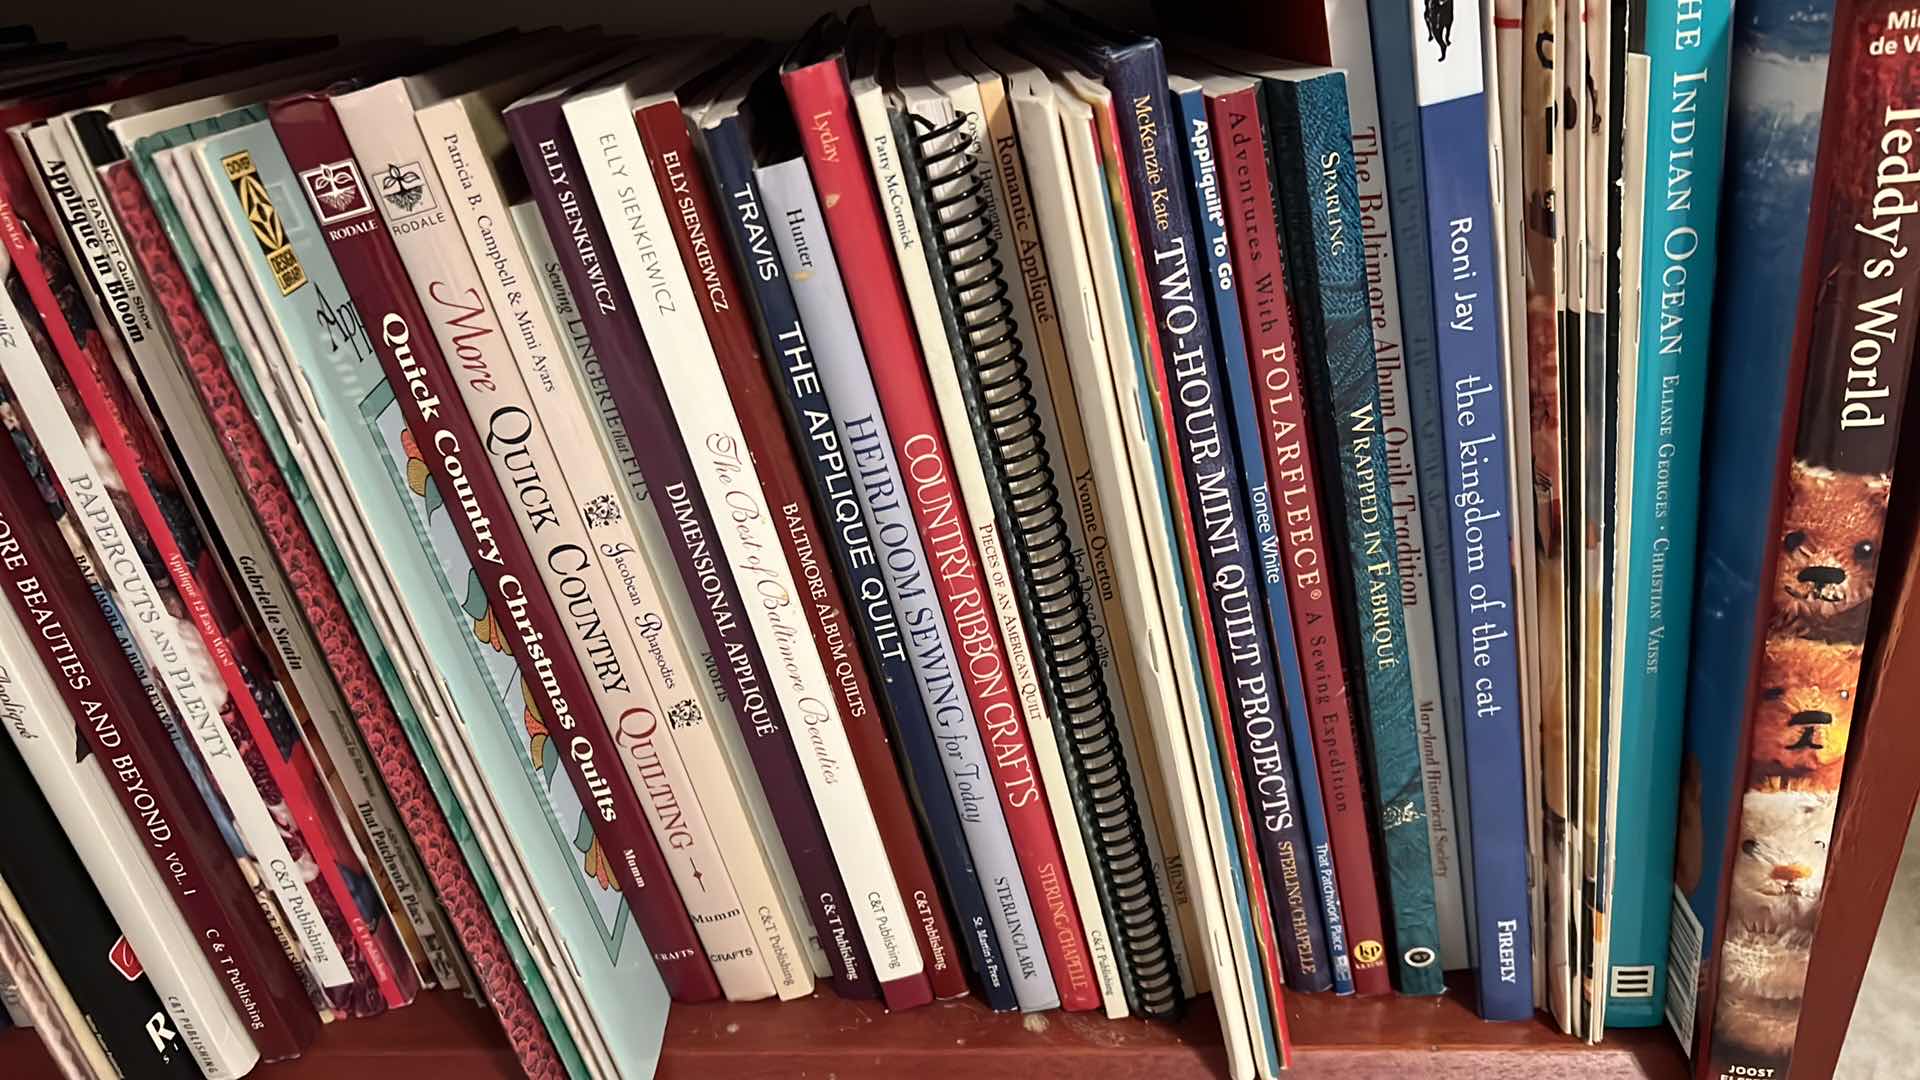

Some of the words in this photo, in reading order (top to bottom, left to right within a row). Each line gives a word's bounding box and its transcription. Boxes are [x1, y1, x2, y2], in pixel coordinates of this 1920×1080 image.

[1869, 36, 1898, 55] de
[813, 111, 839, 162] Lyday
[1134, 96, 1162, 184] McKenzie
[1151, 188, 1169, 230] Kate
[1350, 126, 1378, 184] The
[1667, 71, 1706, 210] INDIAN
[392, 212, 446, 236] RODALE
[540, 140, 569, 184] ELLY
[559, 192, 615, 313] SIENKIEWICZ
[600, 134, 627, 176] ELLY
[618, 187, 675, 314] SIENKIEWICZ
[875, 136, 889, 169] Patty
[885, 174, 913, 249] McCormick
[1229, 113, 1260, 260] Adventures
[1321, 152, 1349, 255] SPARLING
[87, 199, 120, 254] BASKET
[117, 261, 139, 291] Quilt
[133, 296, 151, 329] Show
[329, 220, 378, 240] RODALE
[444, 134, 472, 189] Patricia
[468, 194, 481, 210] B.
[478, 216, 515, 286] Campbell
[508, 292, 521, 305] &
[515, 311, 540, 349] Mimi
[532, 356, 554, 392] Ayars
[663, 151, 689, 192] ELLY
[679, 198, 728, 312] SIENKIEWICZ
[735, 184, 778, 280] TRAVIS
[787, 210, 812, 266] Hunter
[997, 135, 1036, 230] Romantic
[1020, 238, 1056, 322] Appliqué
[1213, 232, 1227, 257] To
[1357, 194, 1387, 330] Baltimore
[1451, 218, 1476, 280] Roni
[94, 254, 112, 275] in
[107, 280, 144, 342] Bloom
[1218, 263, 1232, 289] Go
[1256, 274, 1278, 332] With
[1451, 293, 1476, 330] Jay
[1658, 226, 1697, 354] OCEAN
[545, 259, 578, 313] Sewing
[612, 427, 632, 452] that
[1156, 239, 1219, 462] TWO-HOUR
[1372, 339, 1400, 419] Album
[1843, 288, 1904, 430] World
[1456, 376, 1492, 425] the
[1660, 375, 1679, 435] ELIANE
[706, 434, 741, 482] The
[780, 322, 819, 396] THE
[805, 411, 873, 567] APPLIQUE
[862, 578, 905, 662] QUILT
[1351, 404, 1383, 522] WRAPPED
[1656, 444, 1675, 517] GEORGES
[726, 491, 762, 547] Best
[845, 417, 924, 598] HEIRLOOM
[1076, 469, 1104, 531] Yvonne
[1091, 536, 1117, 600] Overton
[1197, 468, 1239, 555] MINI
[1253, 482, 1270, 532] Tonee
[1262, 535, 1280, 583] White
[1364, 532, 1382, 554] IN
[1455, 435, 1499, 571] kingdom
[383, 314, 439, 420] Quick
[435, 430, 502, 563] Country
[500, 576, 574, 728] Christmas
[571, 737, 616, 821] Quilts
[429, 282, 497, 391] More
[487, 407, 558, 530] QUICK
[548, 545, 629, 692] COUNTRY
[616, 708, 692, 848] QUILTING
[740, 556, 769, 571] of
[1392, 495, 1421, 605] Tradition
[1648, 537, 1669, 618] CHRISTIAN
[70, 475, 159, 623] PAPERCUTS
[150, 630, 177, 662] AND
[169, 668, 231, 758] PLENTY
[76, 553, 125, 634] BALTIMORE
[240, 556, 280, 623] Gabrielle
[273, 628, 301, 669] Swain
[600, 543, 640, 605] Jacobean
[635, 613, 677, 688] Rhapsodies
[667, 484, 735, 635] DIMENSIONAL
[726, 644, 777, 736] APPLIQUÉ
[784, 504, 826, 599] BALTIMORE
[817, 605, 847, 659] ALBUM
[836, 662, 866, 717] QUILTS
[905, 435, 974, 581] COUNTRY
[950, 589, 1006, 697] RIBBON
[985, 703, 1038, 806] CRAFTS
[979, 524, 999, 568] PIECES
[1004, 616, 1029, 679] AMERICAN
[1022, 683, 1041, 719] QUILT
[1214, 565, 1260, 664] QUILT
[1306, 613, 1322, 624] A
[1368, 562, 1398, 669] FABRIQUÉ
[1470, 584, 1506, 612] of
[757, 580, 807, 690] Baltimore
[906, 608, 963, 726] SEWING
[1310, 636, 1330, 704] Sewing
[1472, 624, 1508, 666] the
[1646, 627, 1664, 674] VAISSE
[18, 578, 90, 689] BEAUTIES
[81, 702, 120, 747] AND
[113, 756, 170, 847] BEYOND,
[166, 852, 186, 885] VOL.
[1419, 701, 1439, 765] Maryland
[1476, 678, 1501, 717] cat
[799, 698, 839, 784] Beauties
[937, 736, 967, 761] for
[1238, 675, 1292, 830] PROJECTS
[1323, 714, 1346, 812] Expedition
[947, 764, 983, 827] Today
[1427, 771, 1447, 831] Historical
[359, 801, 378, 828] That
[372, 831, 409, 892] Patchwork
[403, 895, 424, 924] Place
[624, 850, 644, 887] Mumm
[1317, 843, 1329, 866] That
[1435, 836, 1449, 877] Society
[271, 860, 297, 890] C&T
[289, 897, 328, 962] Publishing
[692, 908, 740, 924] Mumm
[868, 892, 885, 912] C&T
[877, 916, 900, 969] Publishing
[914, 891, 931, 914] C&T
[923, 917, 946, 970] Publishing
[995, 877, 1036, 979] STERLING/LARK
[1279, 842, 1315, 972] STERLING/CHAPELLE
[1322, 869, 1339, 922] Patchwork
[711, 948, 753, 963] CRAFTS
[758, 906, 777, 931] C&T
[769, 935, 794, 986] Publishing
[833, 928, 857, 979] Publishing
[977, 930, 993, 963] Martin's
[988, 965, 1000, 987] Press
[1091, 930, 1105, 951] C&T
[1097, 955, 1113, 995] Publishing
[1331, 925, 1342, 950] Place
[1498, 920, 1516, 982] FIREFLY
[227, 969, 264, 1029] Publishing
[181, 1018, 218, 1073] PUBLISHING
[1728, 1064, 1774, 1078] JOOST
